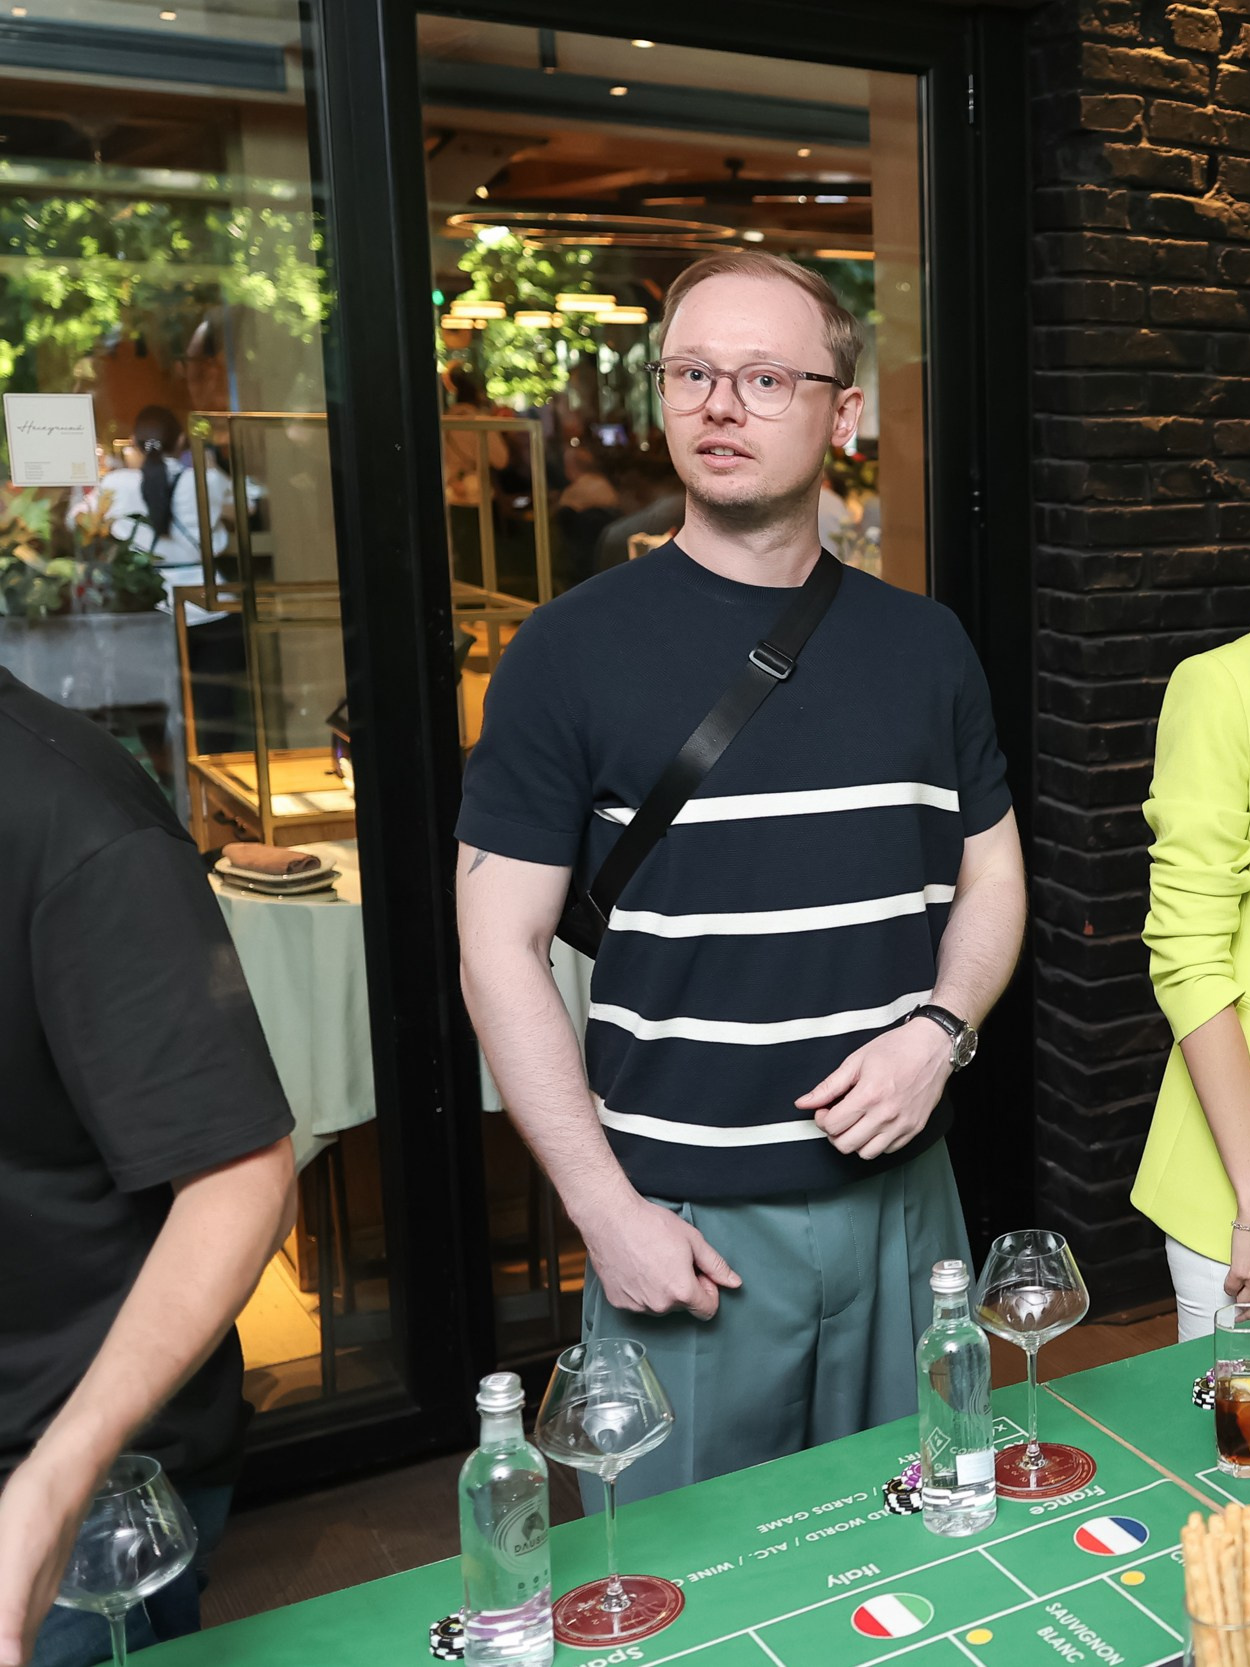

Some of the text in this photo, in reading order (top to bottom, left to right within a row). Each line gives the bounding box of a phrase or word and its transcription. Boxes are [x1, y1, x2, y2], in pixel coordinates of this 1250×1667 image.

[812, 1492, 868, 1515] CARDS
[1029, 1484, 1106, 1515] France
[756, 1511, 810, 1534] GAME
[805, 1517, 866, 1542] WORLD
[748, 1542, 788, 1560] ALC.
[687, 1562, 735, 1583] WINE
[827, 1563, 881, 1588] Italy
[1036, 1626, 1085, 1664] BLANC
[1045, 1602, 1125, 1667] SAUVIGNON
